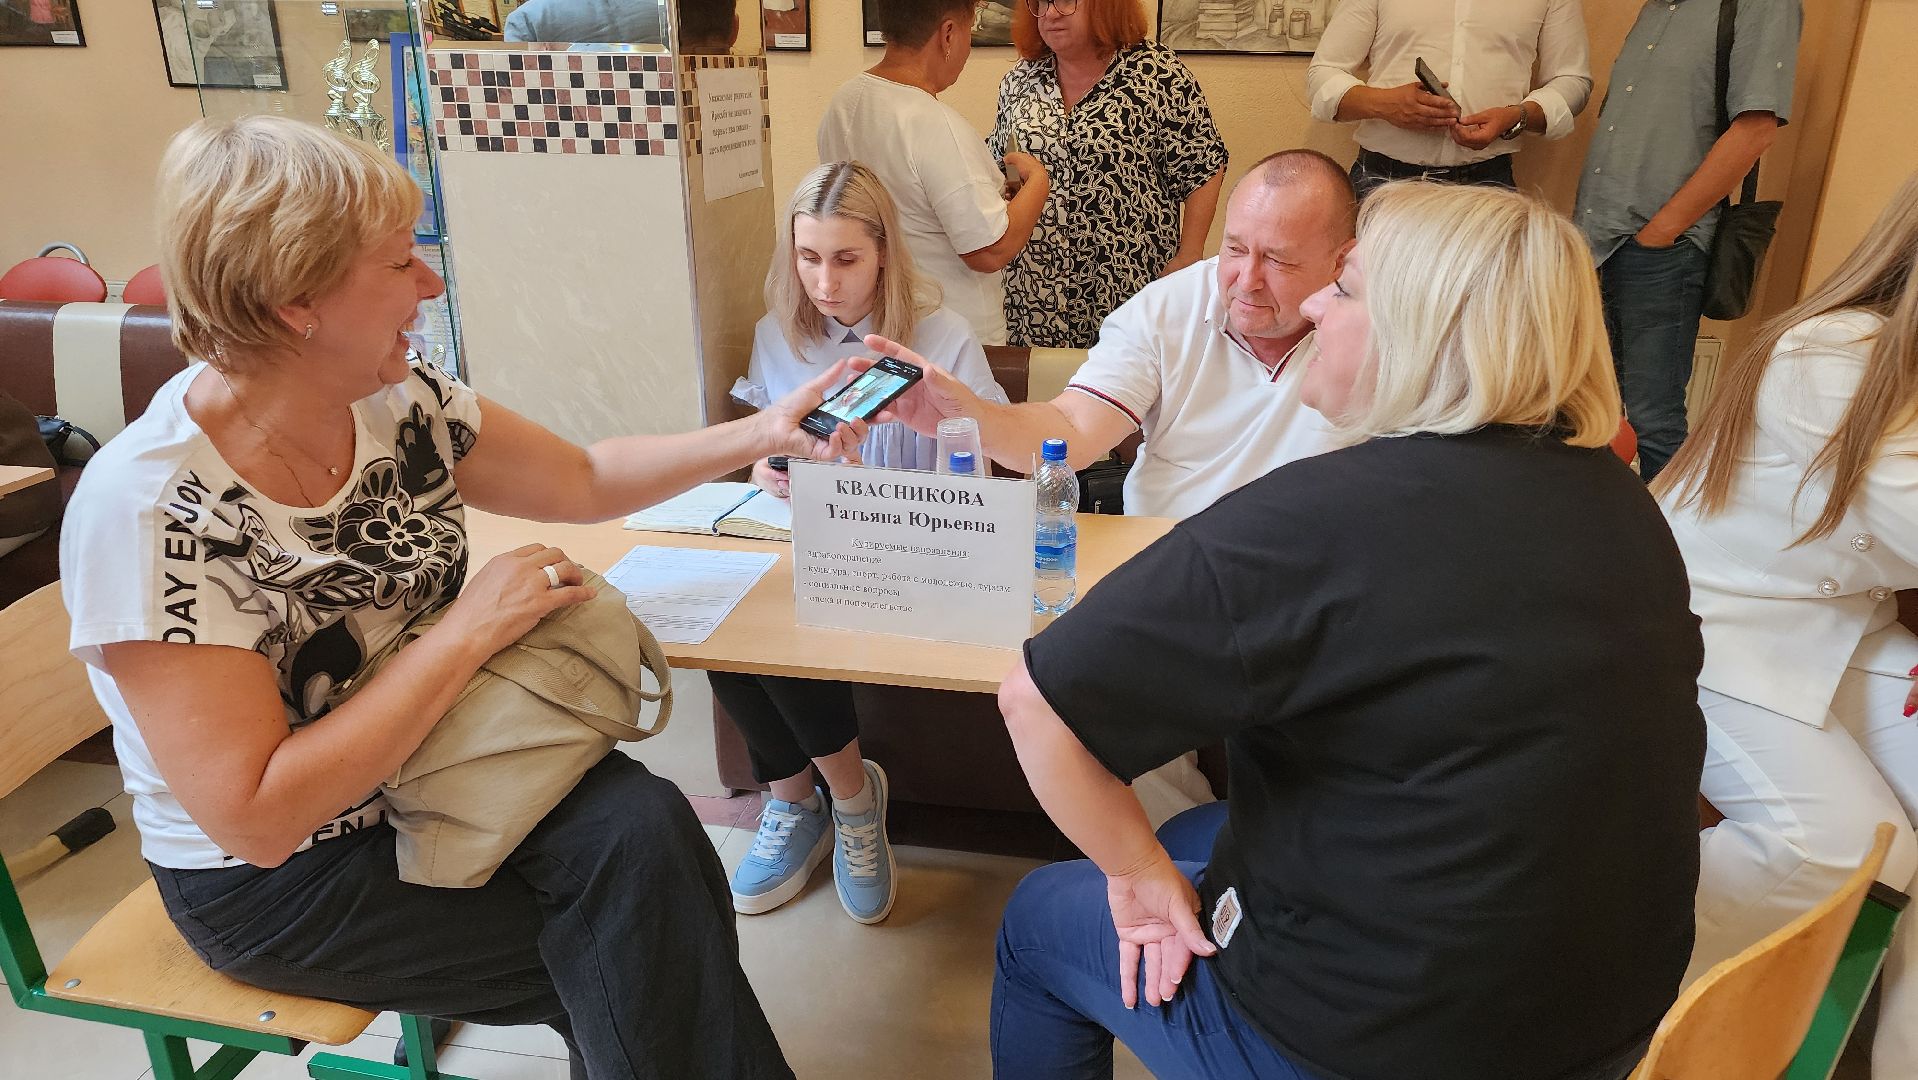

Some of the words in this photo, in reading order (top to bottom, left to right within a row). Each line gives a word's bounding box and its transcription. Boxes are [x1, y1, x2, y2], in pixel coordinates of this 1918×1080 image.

[164, 469, 211, 562] ENJOY
[825, 503, 902, 525] Татьяна
[908, 511, 996, 534] Юрьевна
[836, 479, 985, 507] КВАСНИКОВА
[162, 571, 198, 644] DAY
